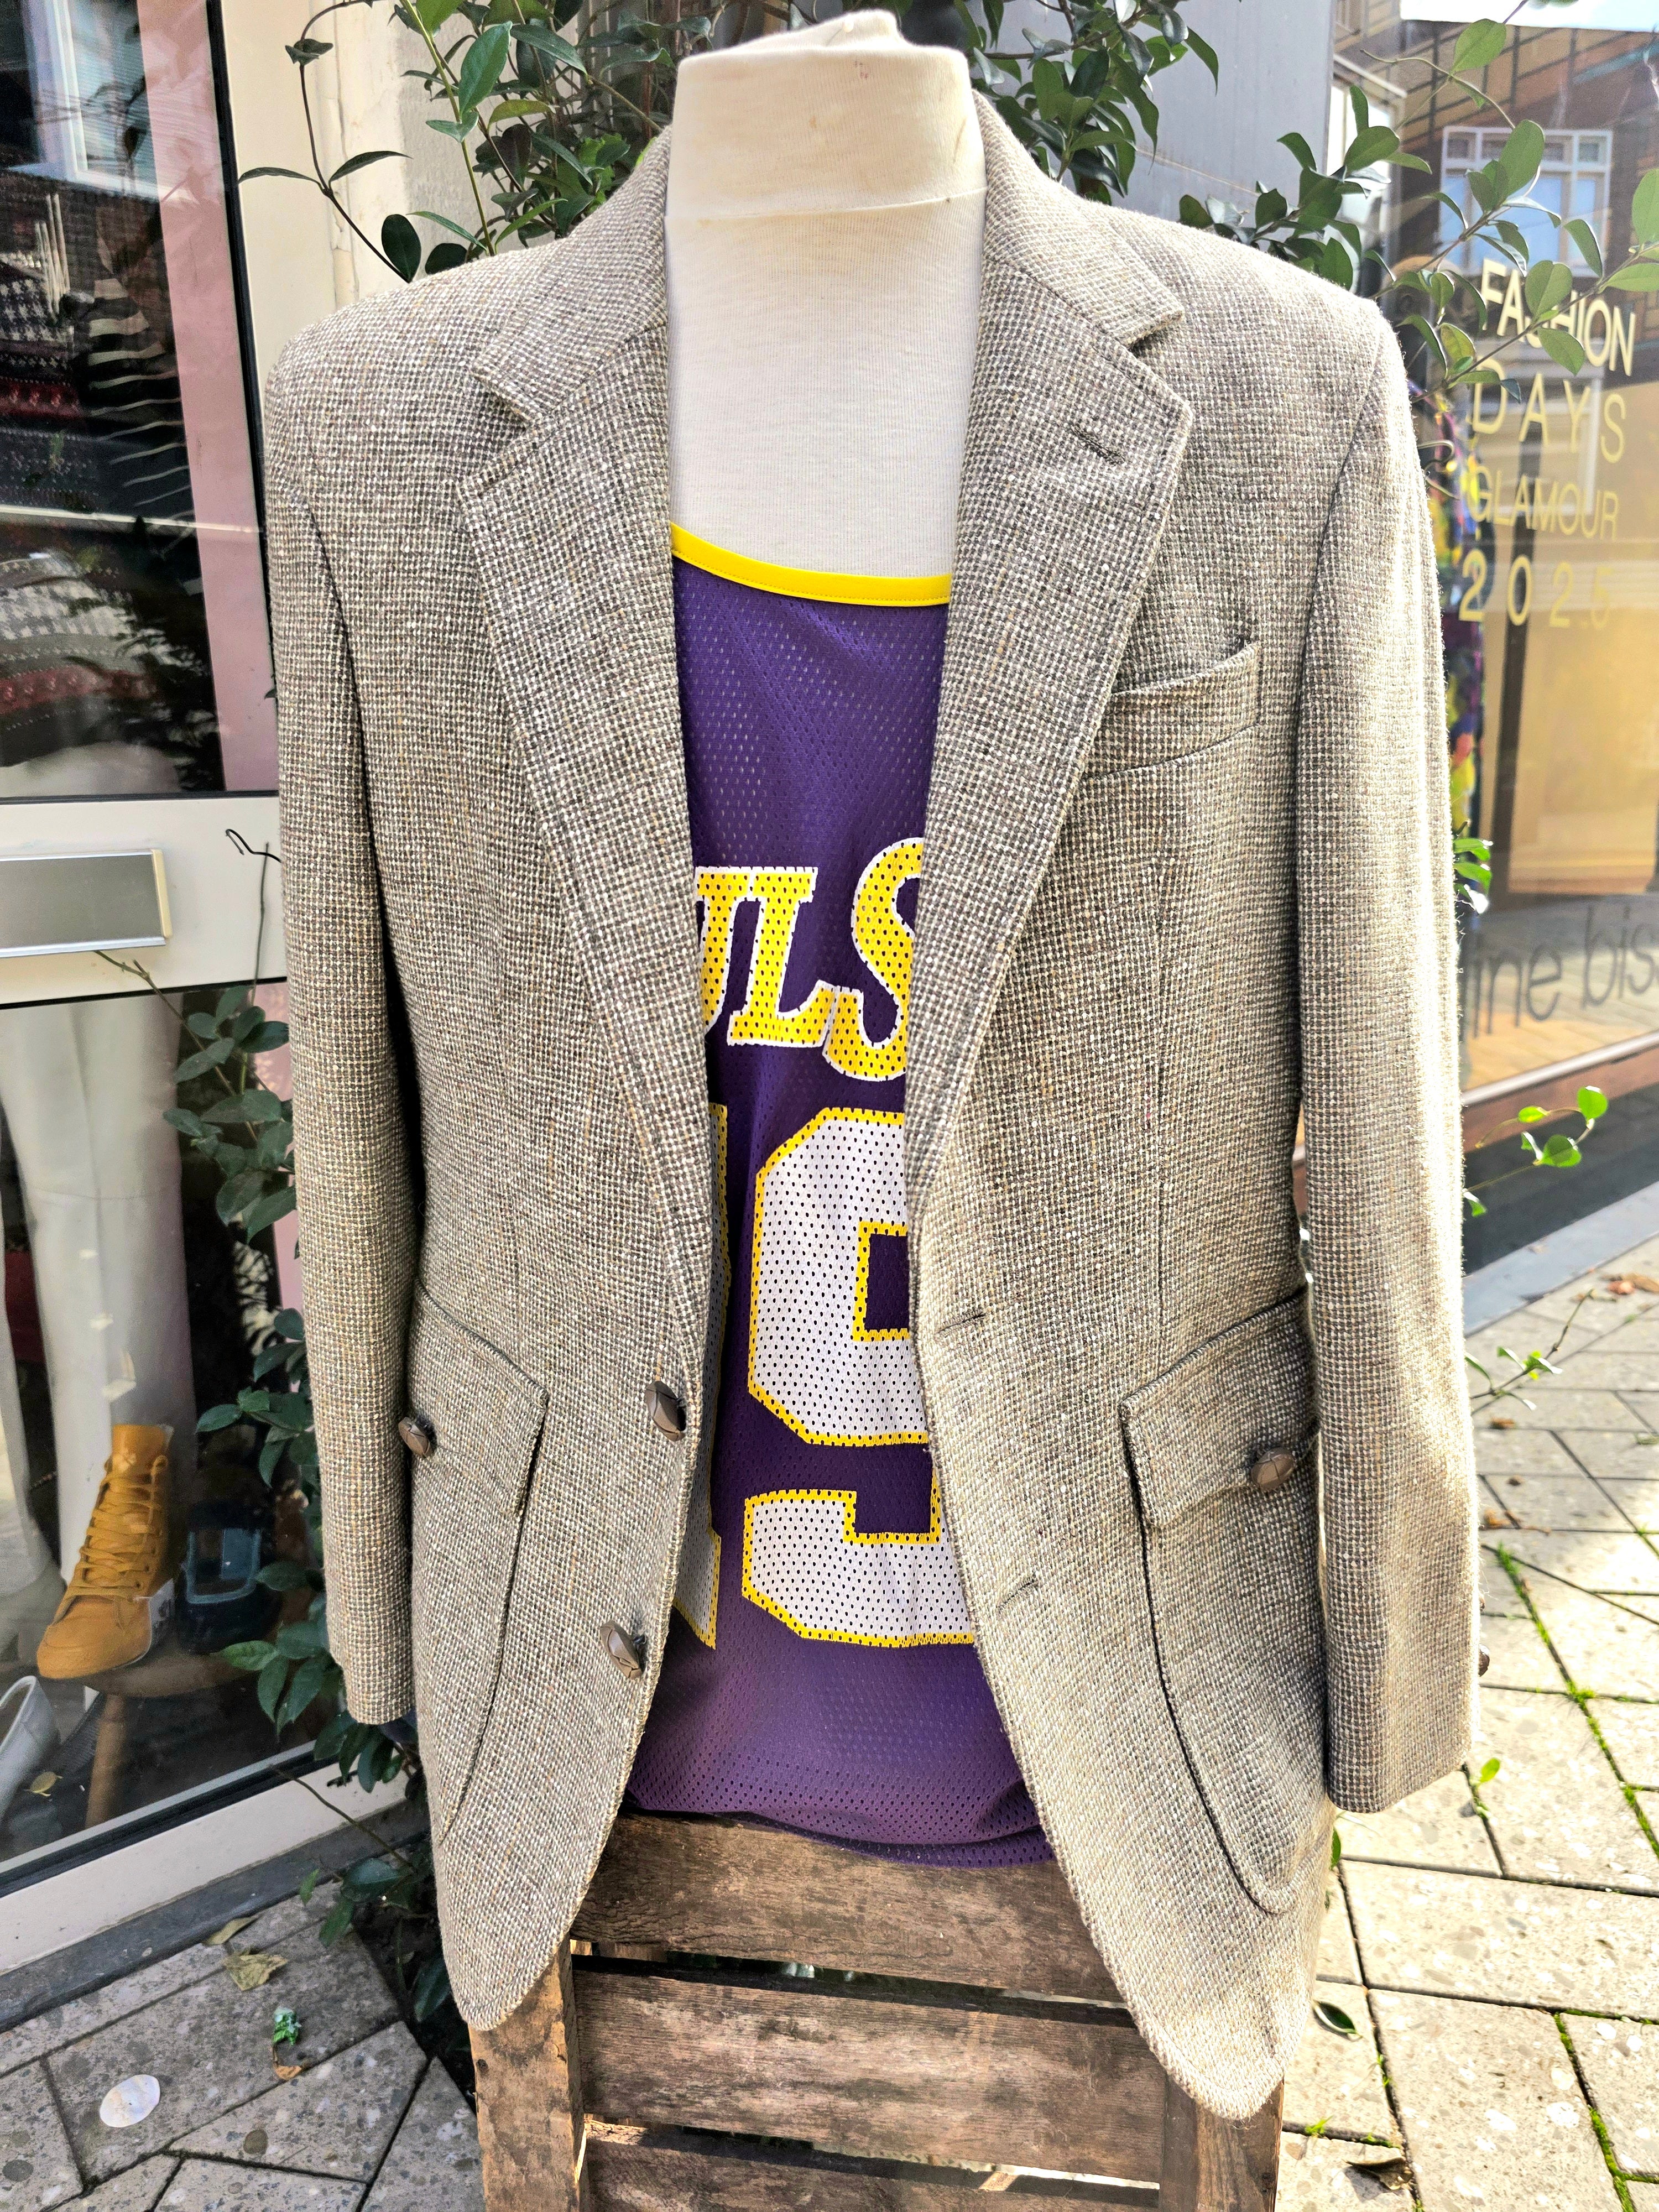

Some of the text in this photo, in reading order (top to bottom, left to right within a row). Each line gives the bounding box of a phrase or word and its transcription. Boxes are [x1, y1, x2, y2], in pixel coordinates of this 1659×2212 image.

[1472, 354, 1626, 463] DAYS
[1467, 466, 1619, 541] GLAMOUR
[1459, 549, 1615, 629] 2025
[1459, 904, 1659, 1042] ine bis
